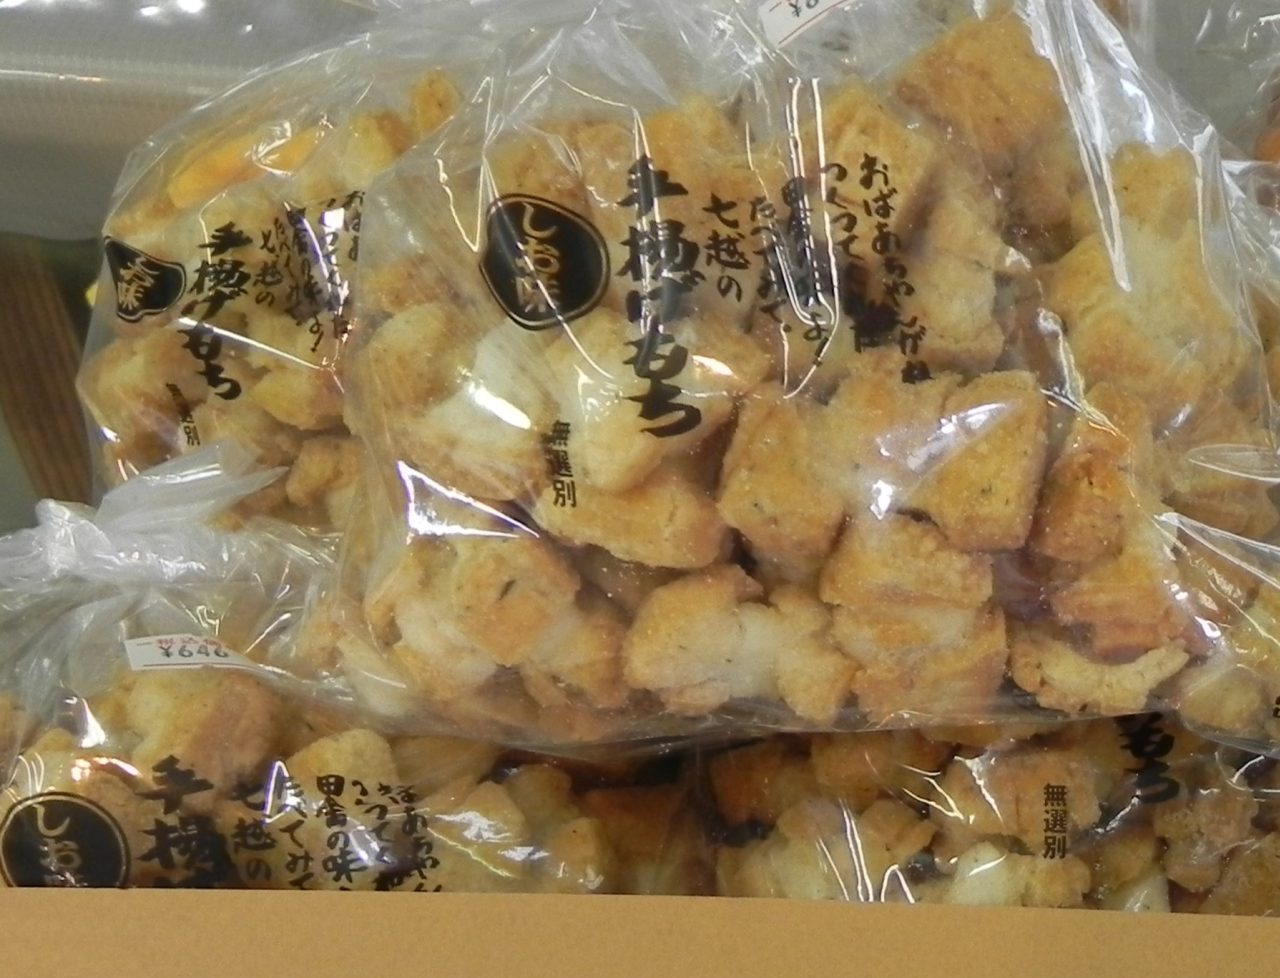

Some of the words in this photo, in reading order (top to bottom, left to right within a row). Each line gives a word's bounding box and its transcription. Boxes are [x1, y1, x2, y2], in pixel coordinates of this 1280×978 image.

[702, 192, 750, 303] 七越の
[1042, 783, 1069, 860] 無選別
